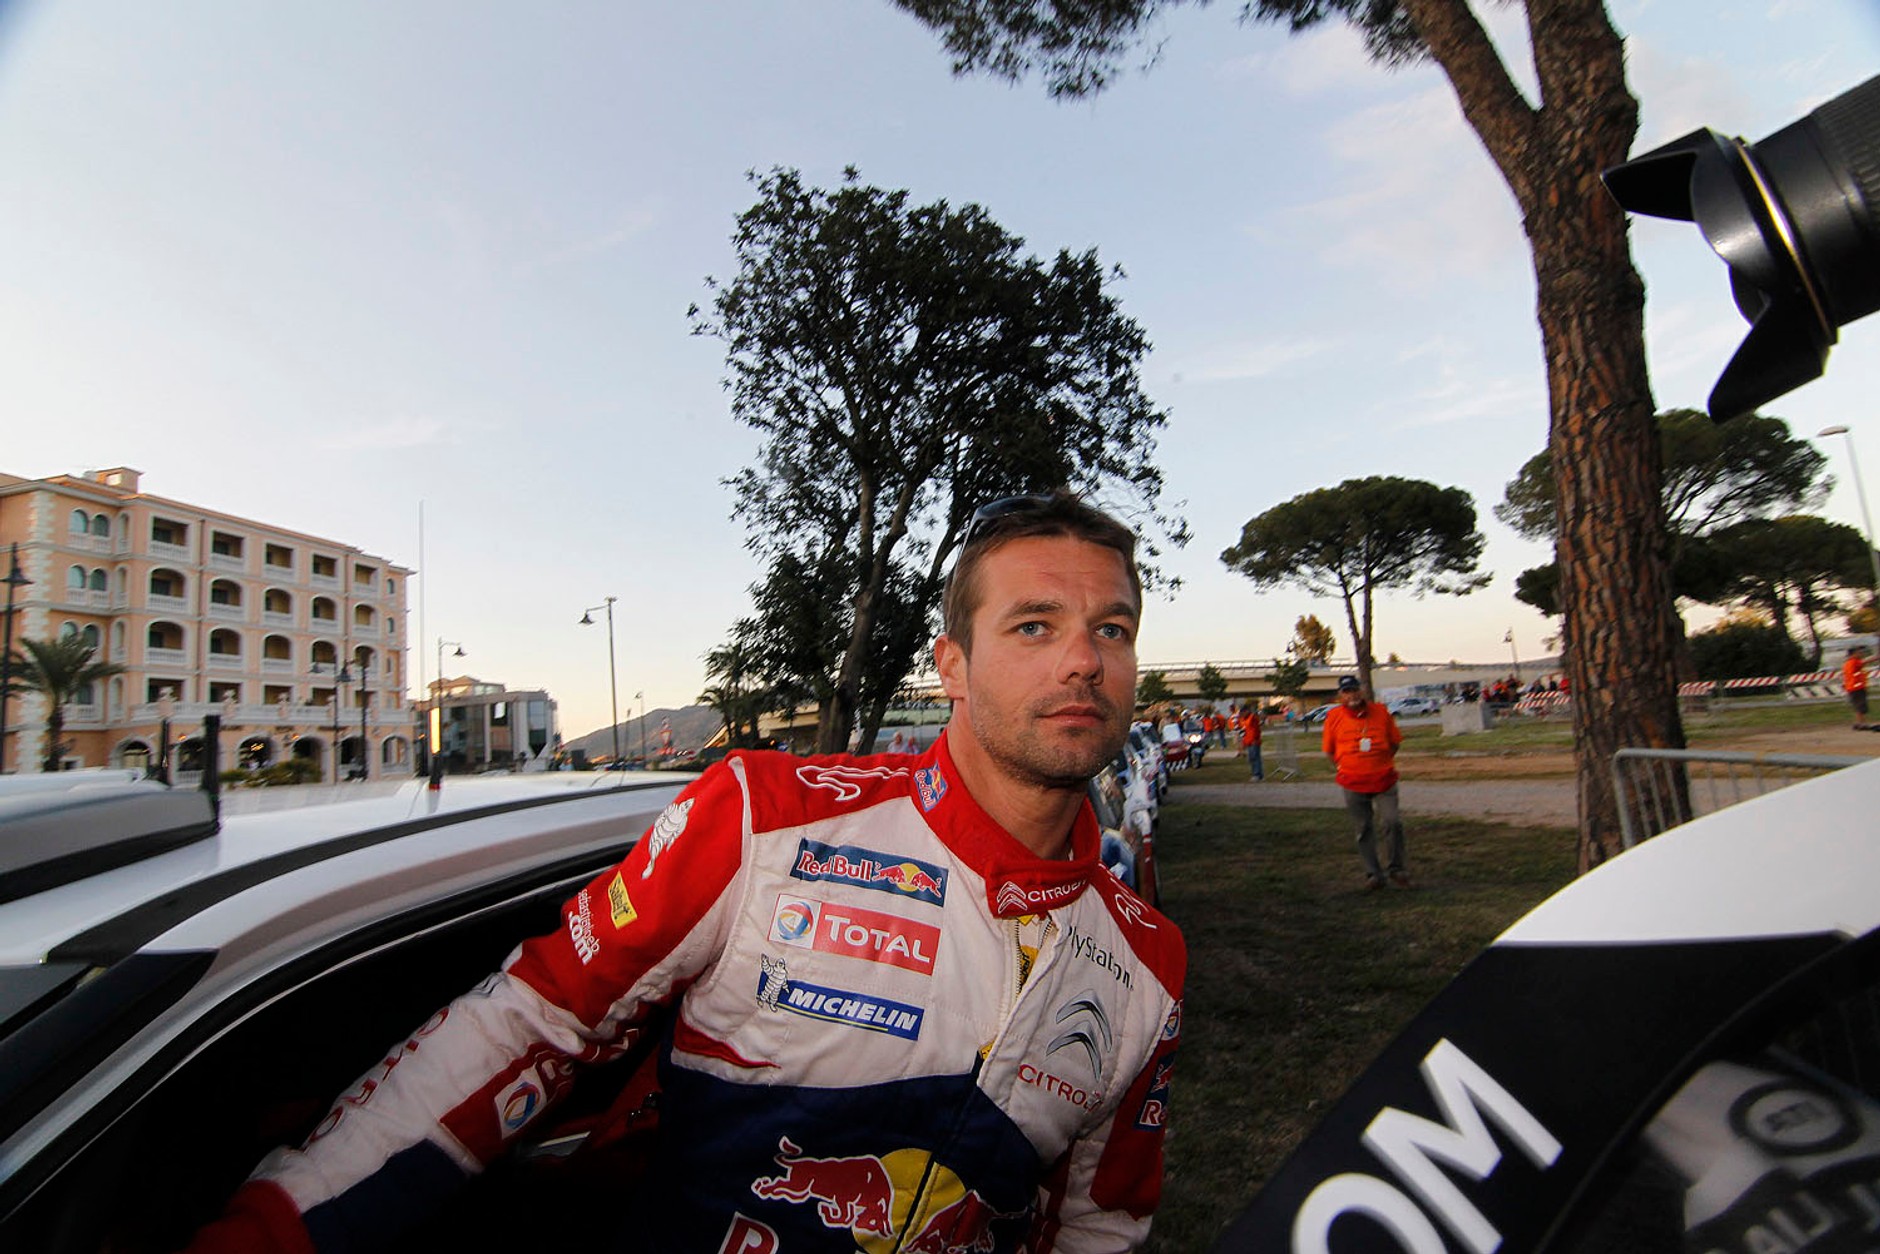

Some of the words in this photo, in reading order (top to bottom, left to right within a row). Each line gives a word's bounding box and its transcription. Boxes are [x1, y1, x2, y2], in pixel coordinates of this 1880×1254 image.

[797, 851, 832, 875] Red
[833, 855, 873, 881] Bull
[568, 911, 593, 966] .com
[825, 914, 930, 963] TOTAL
[788, 988, 918, 1031] MICHELIN
